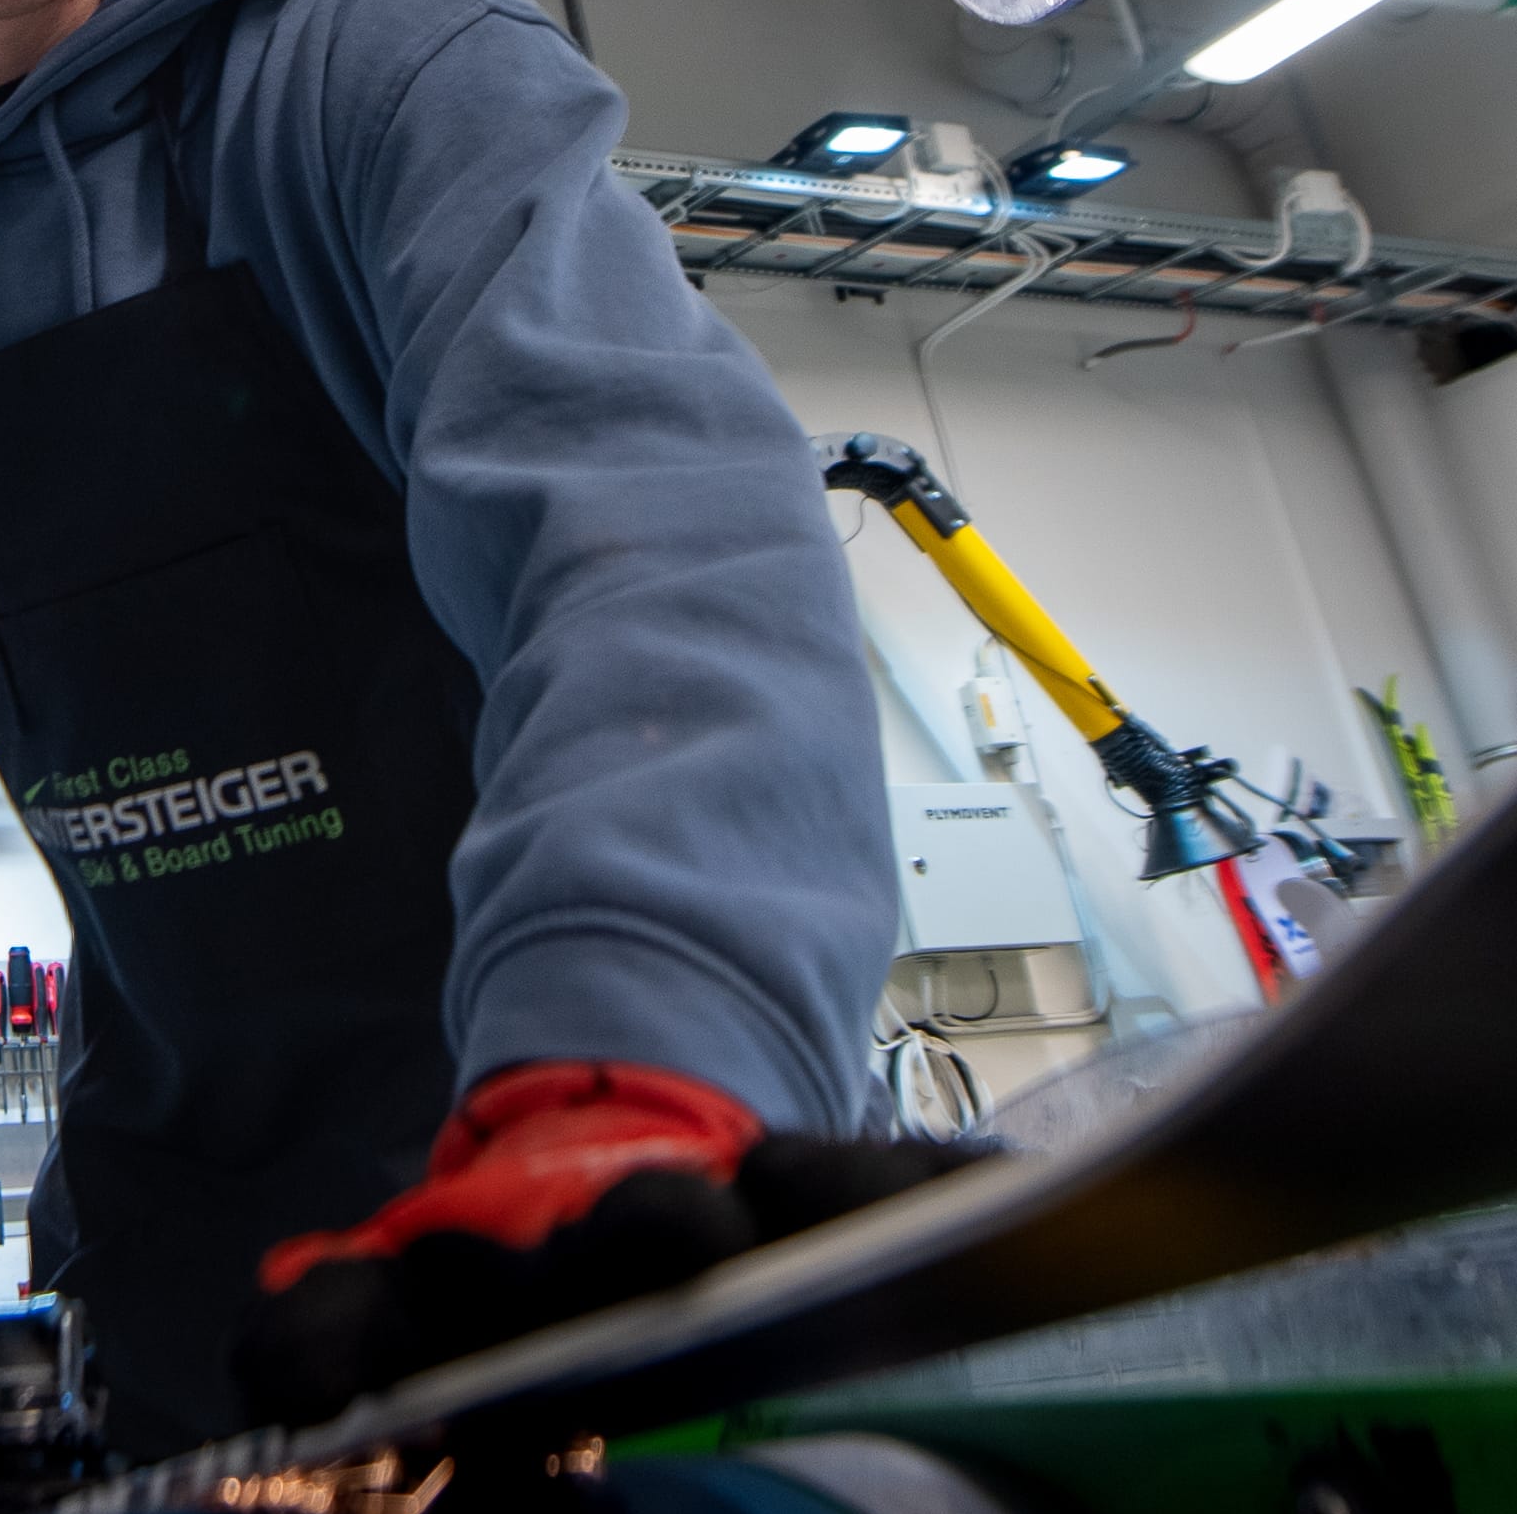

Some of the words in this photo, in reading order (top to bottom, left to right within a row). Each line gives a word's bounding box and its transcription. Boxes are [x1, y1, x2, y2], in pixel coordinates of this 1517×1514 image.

[106, 749, 190, 789] Class
[924, 806, 1011, 820] PLYMOVENT
[120, 852, 141, 883] &
[143, 836, 231, 878] Board
[236, 807, 344, 855] Tuning
